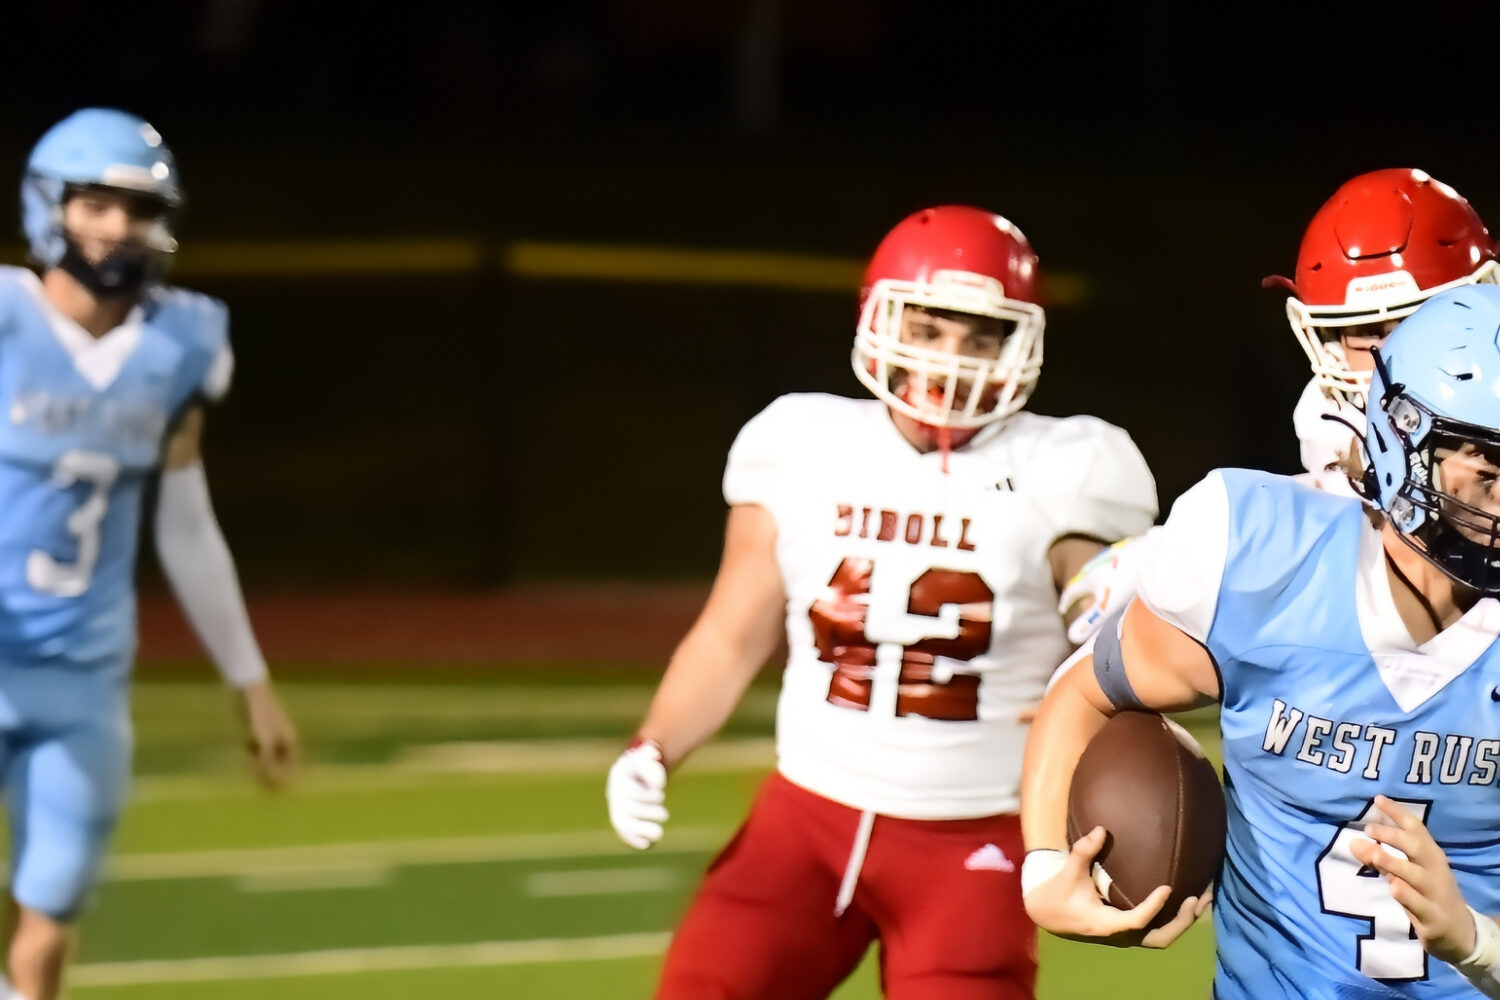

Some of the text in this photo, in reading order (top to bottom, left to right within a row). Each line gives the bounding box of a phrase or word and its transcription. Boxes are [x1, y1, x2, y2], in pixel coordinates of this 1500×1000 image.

[26, 449, 119, 597] 3
[809, 556, 995, 721] 42
[1262, 698, 1396, 780] WEST
[1315, 795, 1432, 982] 4
